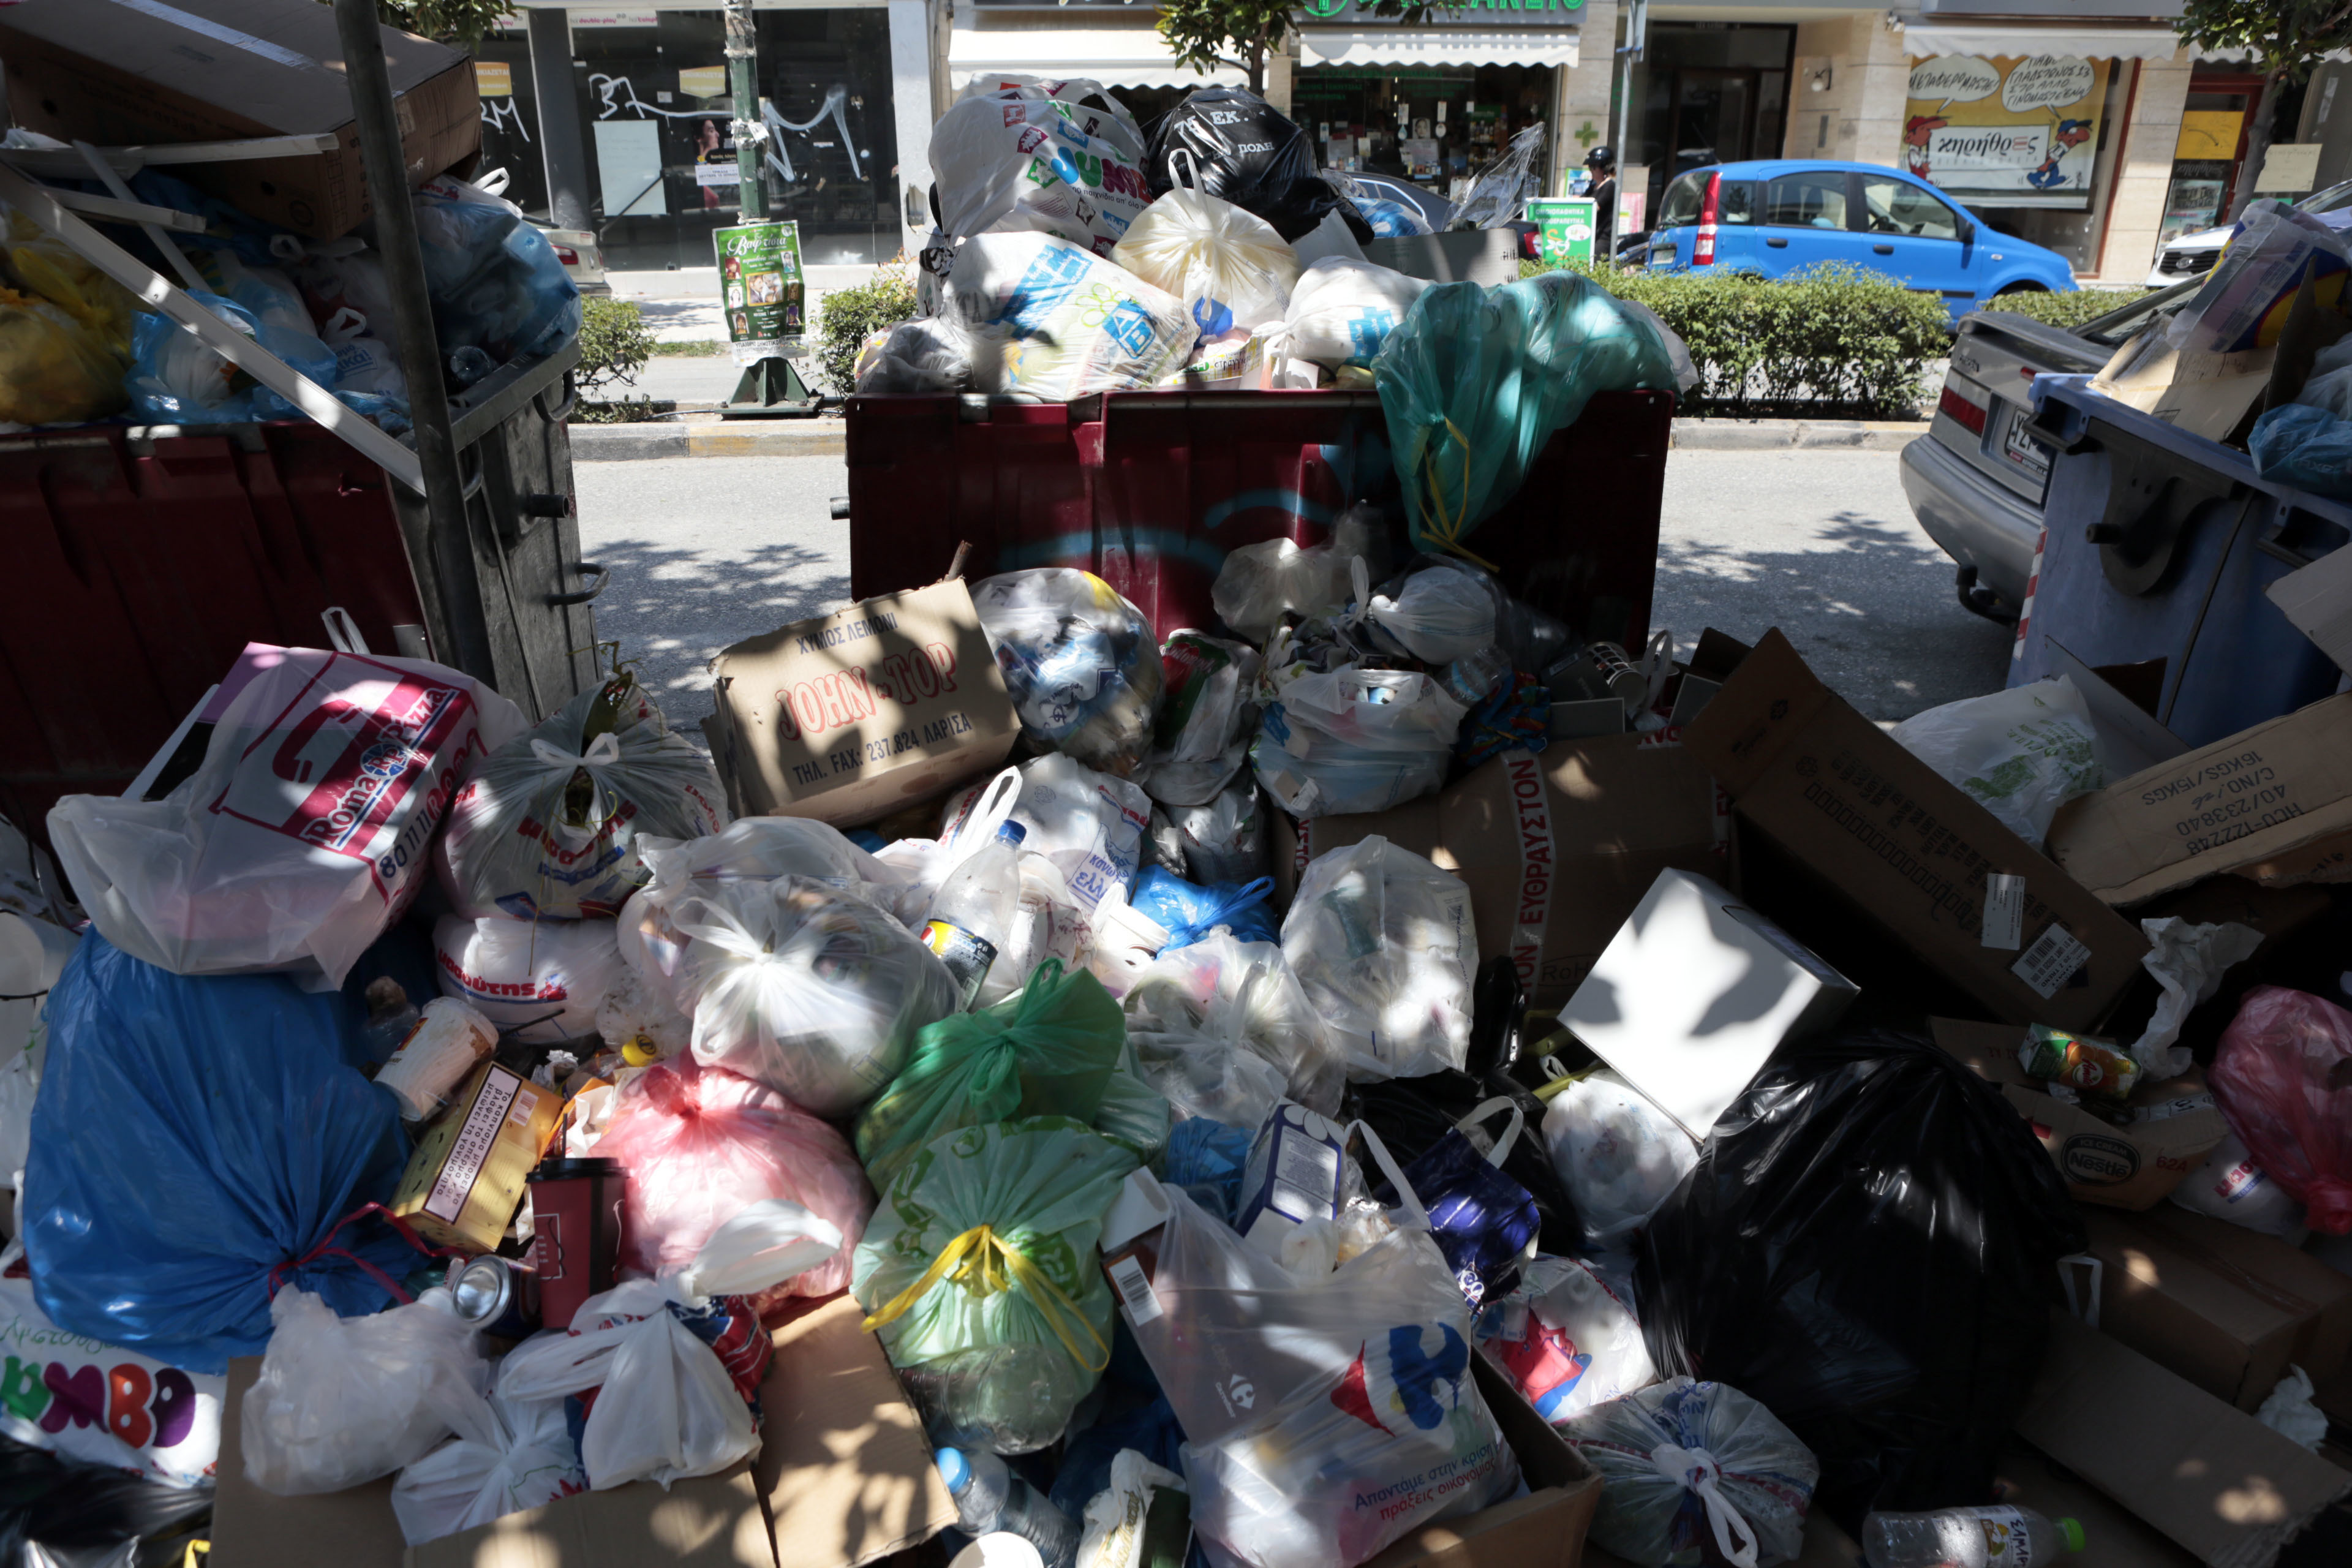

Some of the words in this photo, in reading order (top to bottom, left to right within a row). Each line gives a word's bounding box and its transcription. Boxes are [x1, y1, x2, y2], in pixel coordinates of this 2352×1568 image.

[796, 625, 843, 655] ΧΥΜΟΣ
[846, 612, 898, 642] ΛΕΜΟΝΙ
[383, 688, 448, 742] Pizza
[793, 760, 829, 786] ΤΗΛ.
[833, 747, 864, 774] FAX:
[865, 733, 920, 763] 237.824
[924, 712, 973, 745] ΛΑΡΙΣΑ
[2141, 751, 2263, 806] 16KGS/15KGS
[307, 778, 380, 846] Roma
[2176, 784, 2286, 836] 40/233840
[379, 843, 407, 878] 80
[1506, 760, 1554, 925] ΕΥΘΡΑΥΣΤΟΝ
[501, 1091, 512, 1102] Το
[1354, 1474, 1427, 1512] Απαντάμε
[1428, 1460, 1457, 1486] στην
[1460, 1442, 1501, 1472] κρίση
[1378, 1489, 1435, 1523] πράξεις
[1437, 1457, 1498, 1496] οικονομίας
